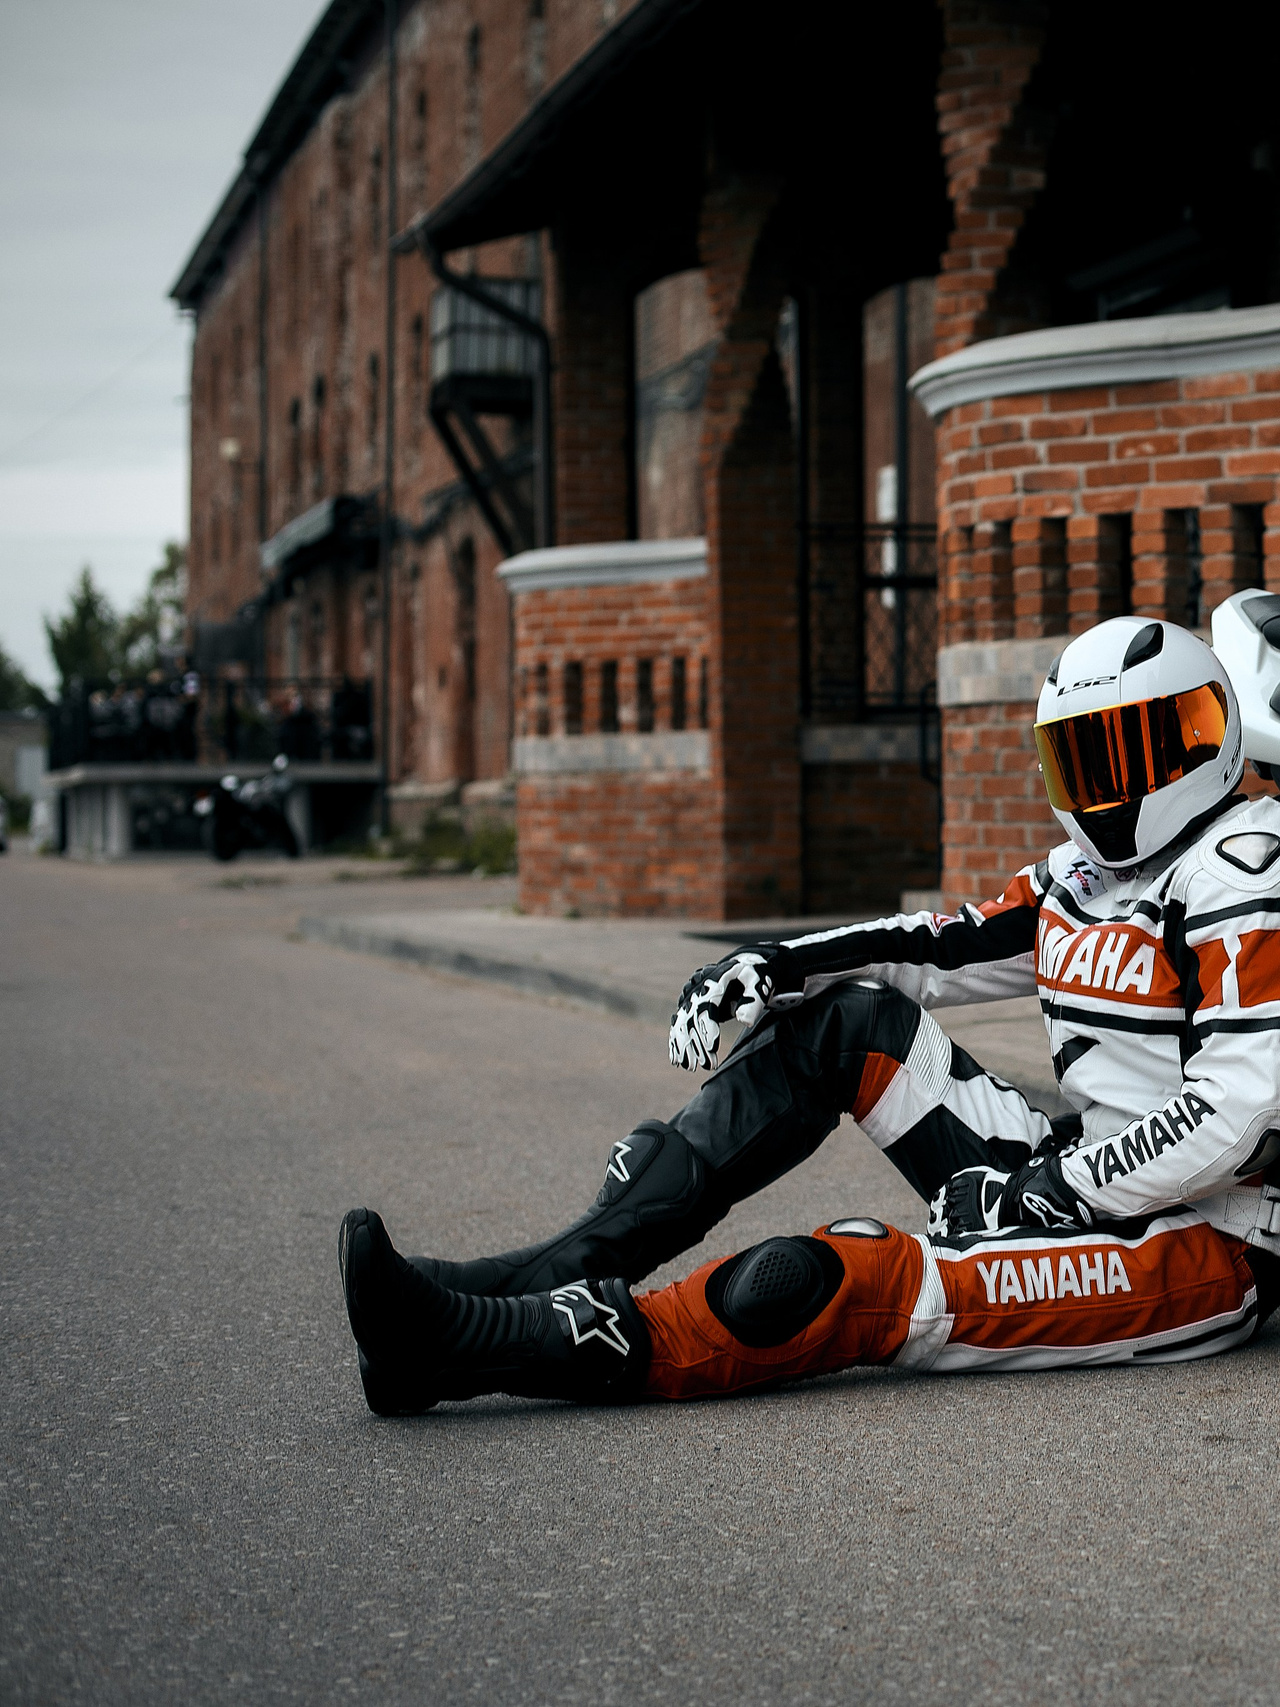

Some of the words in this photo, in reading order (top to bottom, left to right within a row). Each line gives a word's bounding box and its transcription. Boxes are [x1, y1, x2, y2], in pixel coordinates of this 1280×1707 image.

[1057, 675, 1117, 697] LS2
[1038, 917, 1156, 996] MAHA
[1083, 1091, 1216, 1189] YAMAHA
[976, 1250, 1132, 1304] YAMAHA
